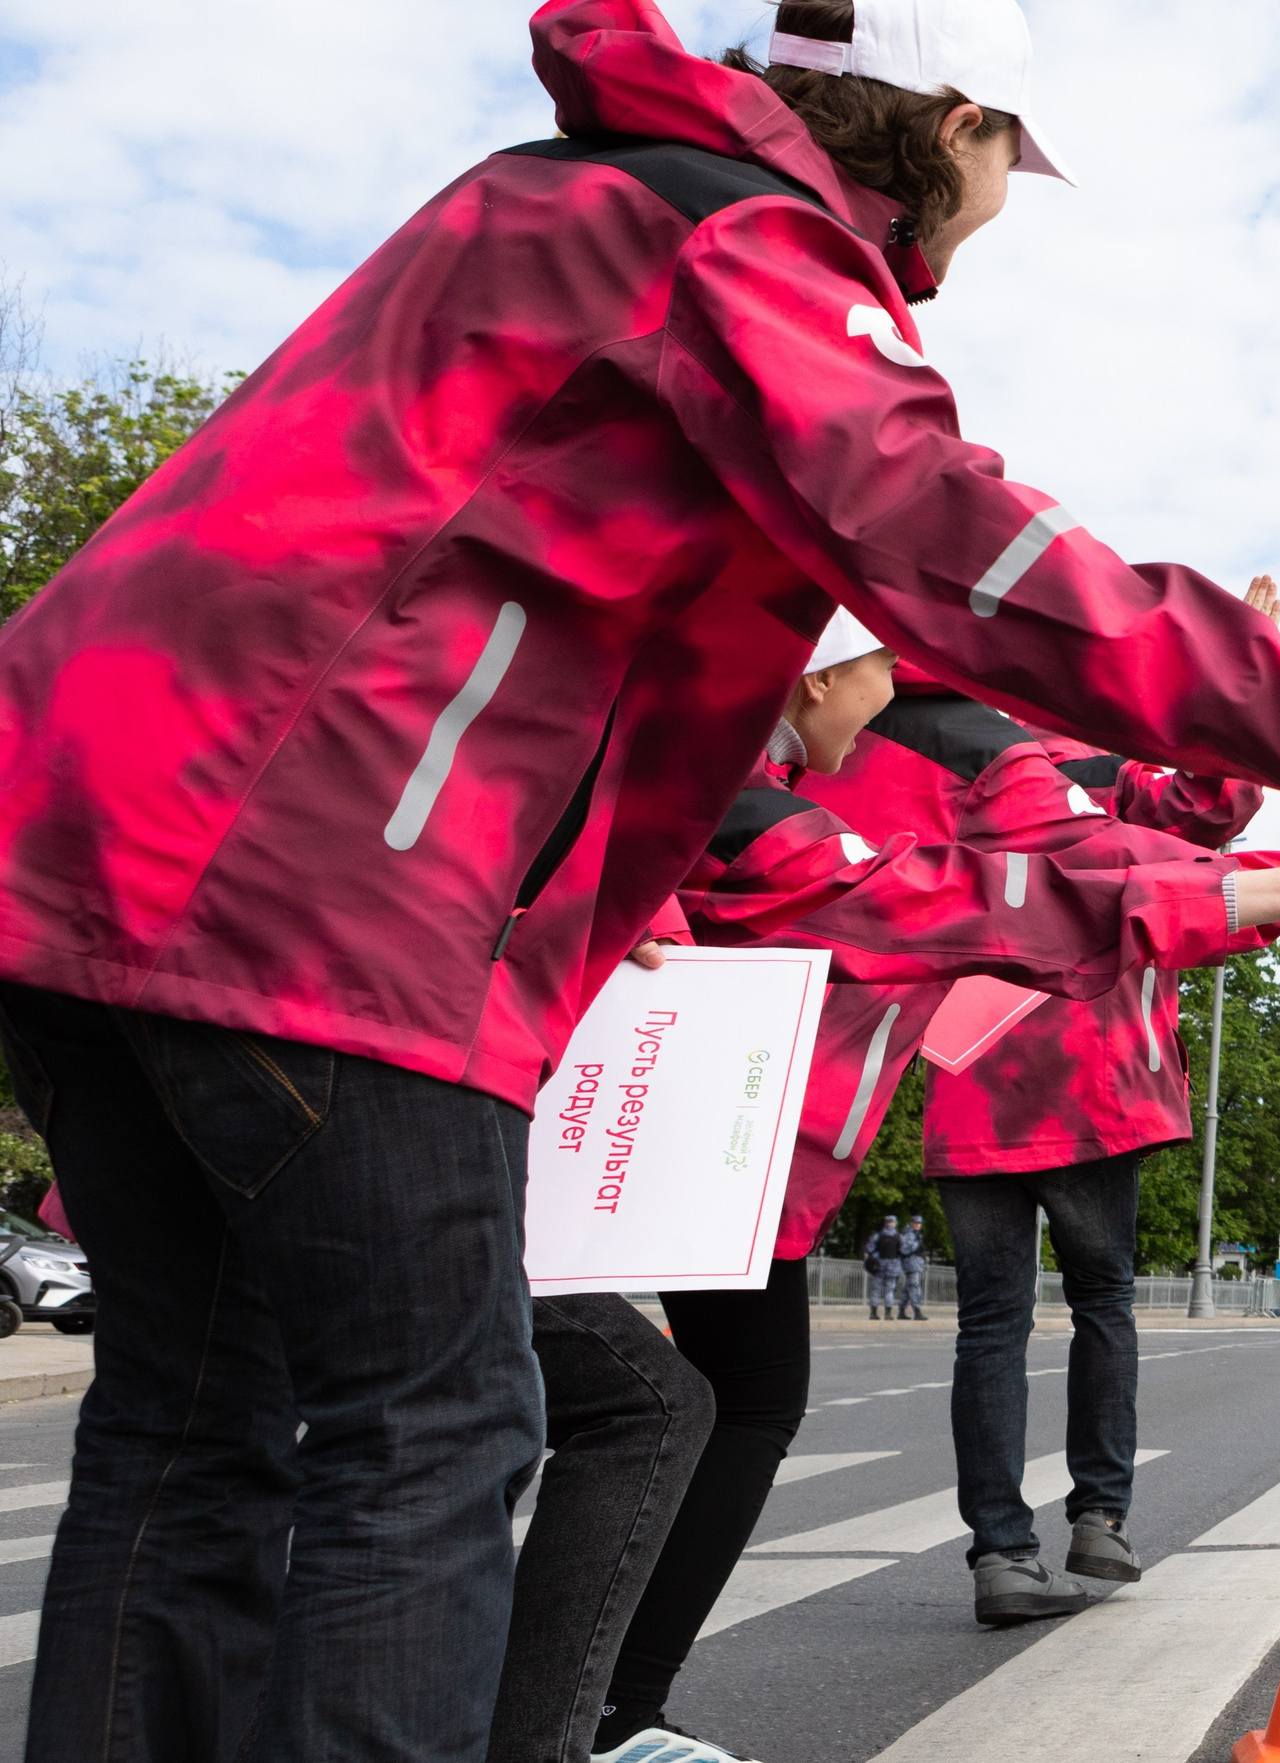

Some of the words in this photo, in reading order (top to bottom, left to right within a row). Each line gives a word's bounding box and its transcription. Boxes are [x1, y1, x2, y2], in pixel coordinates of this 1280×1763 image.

[631, 1010, 678, 1077] Пусть
[558, 1064, 604, 1153] радует
[744, 1067, 763, 1099] СБЕР
[594, 1084, 649, 1214] результат
[729, 1115, 744, 1151] марафон
[740, 1119, 755, 1154] зелёный
